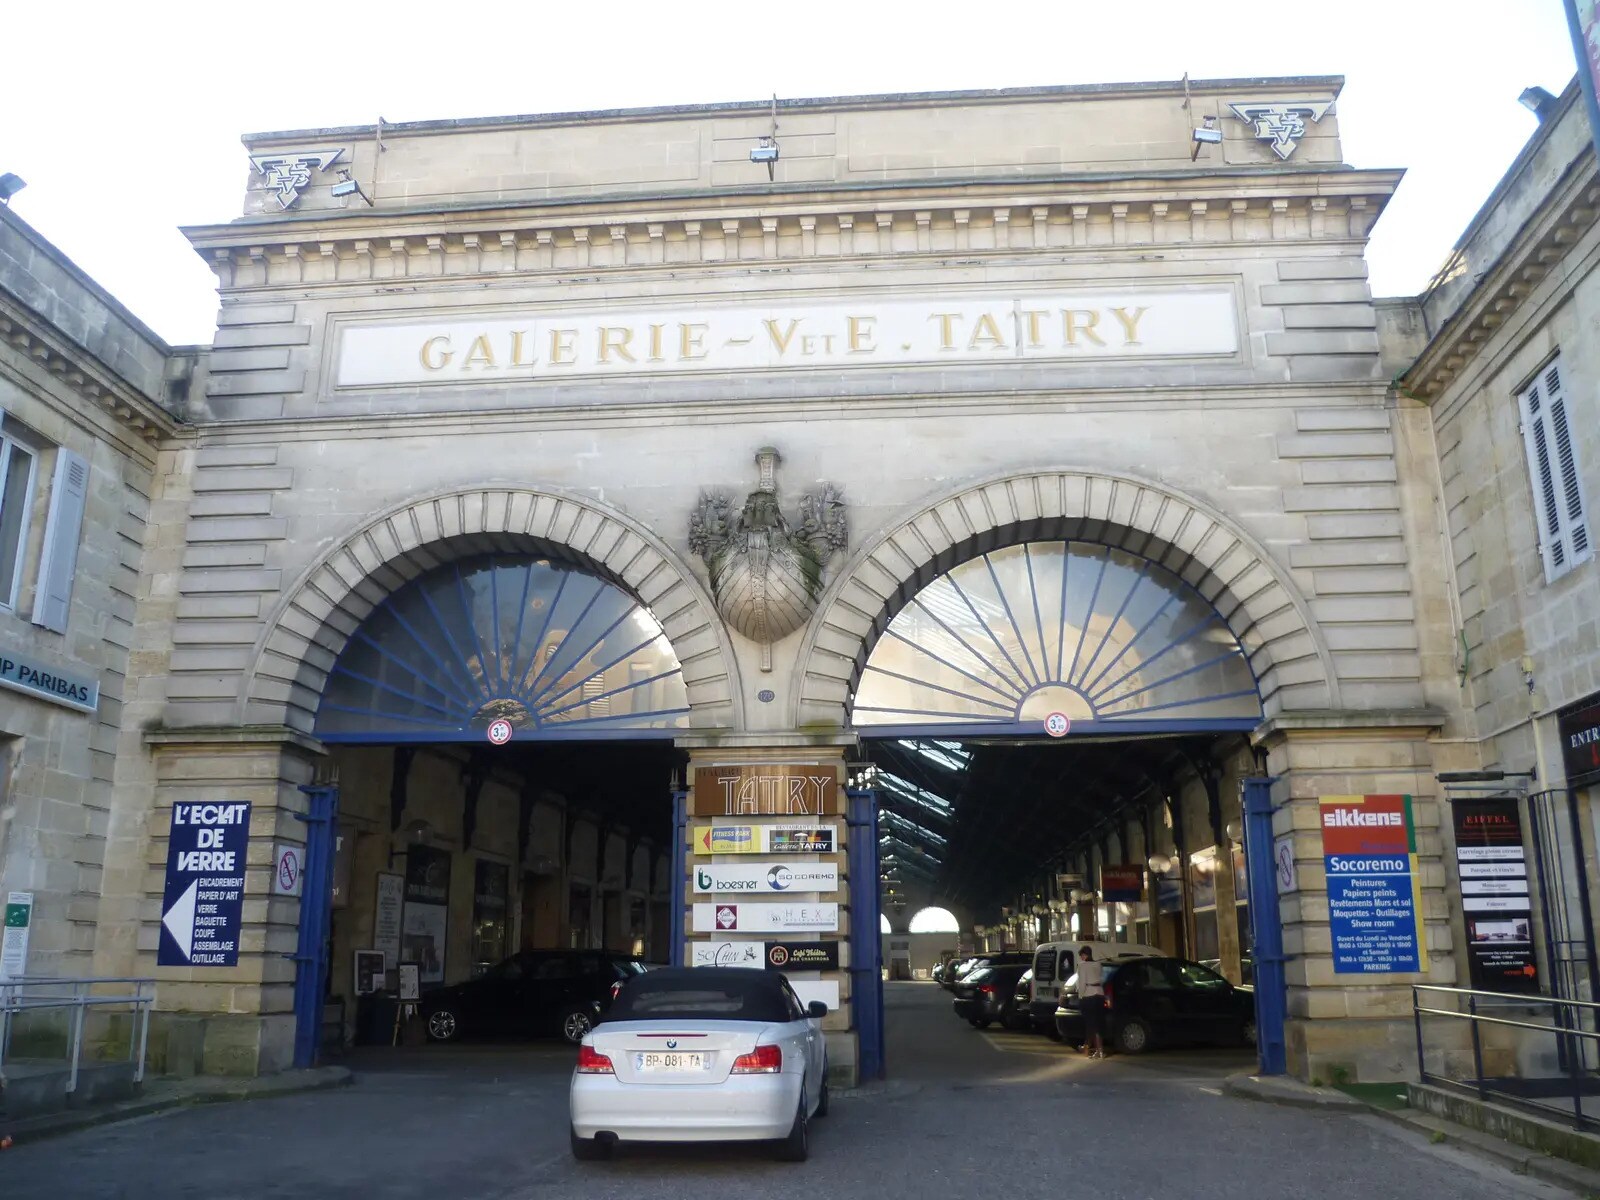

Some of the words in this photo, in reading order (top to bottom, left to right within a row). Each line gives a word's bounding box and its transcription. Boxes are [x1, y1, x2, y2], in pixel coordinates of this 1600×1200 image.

[419, 322, 711, 371] GALERIE
[926, 305, 1154, 352] TATRY
[18, 665, 88, 701] PARIBAS
[718, 775, 831, 815] TATRY
[1324, 809, 1402, 826] sikkens
[197, 829, 225, 848] DE
[177, 851, 236, 871] VERRE
[1331, 857, 1403, 871] Socoremo
[199, 878, 243, 887] ENCADREMENT
[717, 879, 758, 889] boesner
[1351, 879, 1386, 887] Peintures
[198, 891, 219, 900] PAPIER
[1343, 889, 1371, 898] Papiers
[1373, 889, 1396, 898] peints
[1330, 899, 1373, 907] Revêtements
[1374, 899, 1391, 907] Murs
[1401, 898, 1411, 907] sol
[198, 904, 217, 914] VERRE
[1333, 909, 1369, 918] Moquettes
[1376, 908, 1410, 918] Outillages
[195, 917, 227, 926] BAGUETTE
[1351, 919, 1372, 928] Show
[194, 929, 215, 938] COUPE
[193, 941, 234, 950] ASSEMBLAGE
[192, 954, 225, 963] OUTILLAGE
